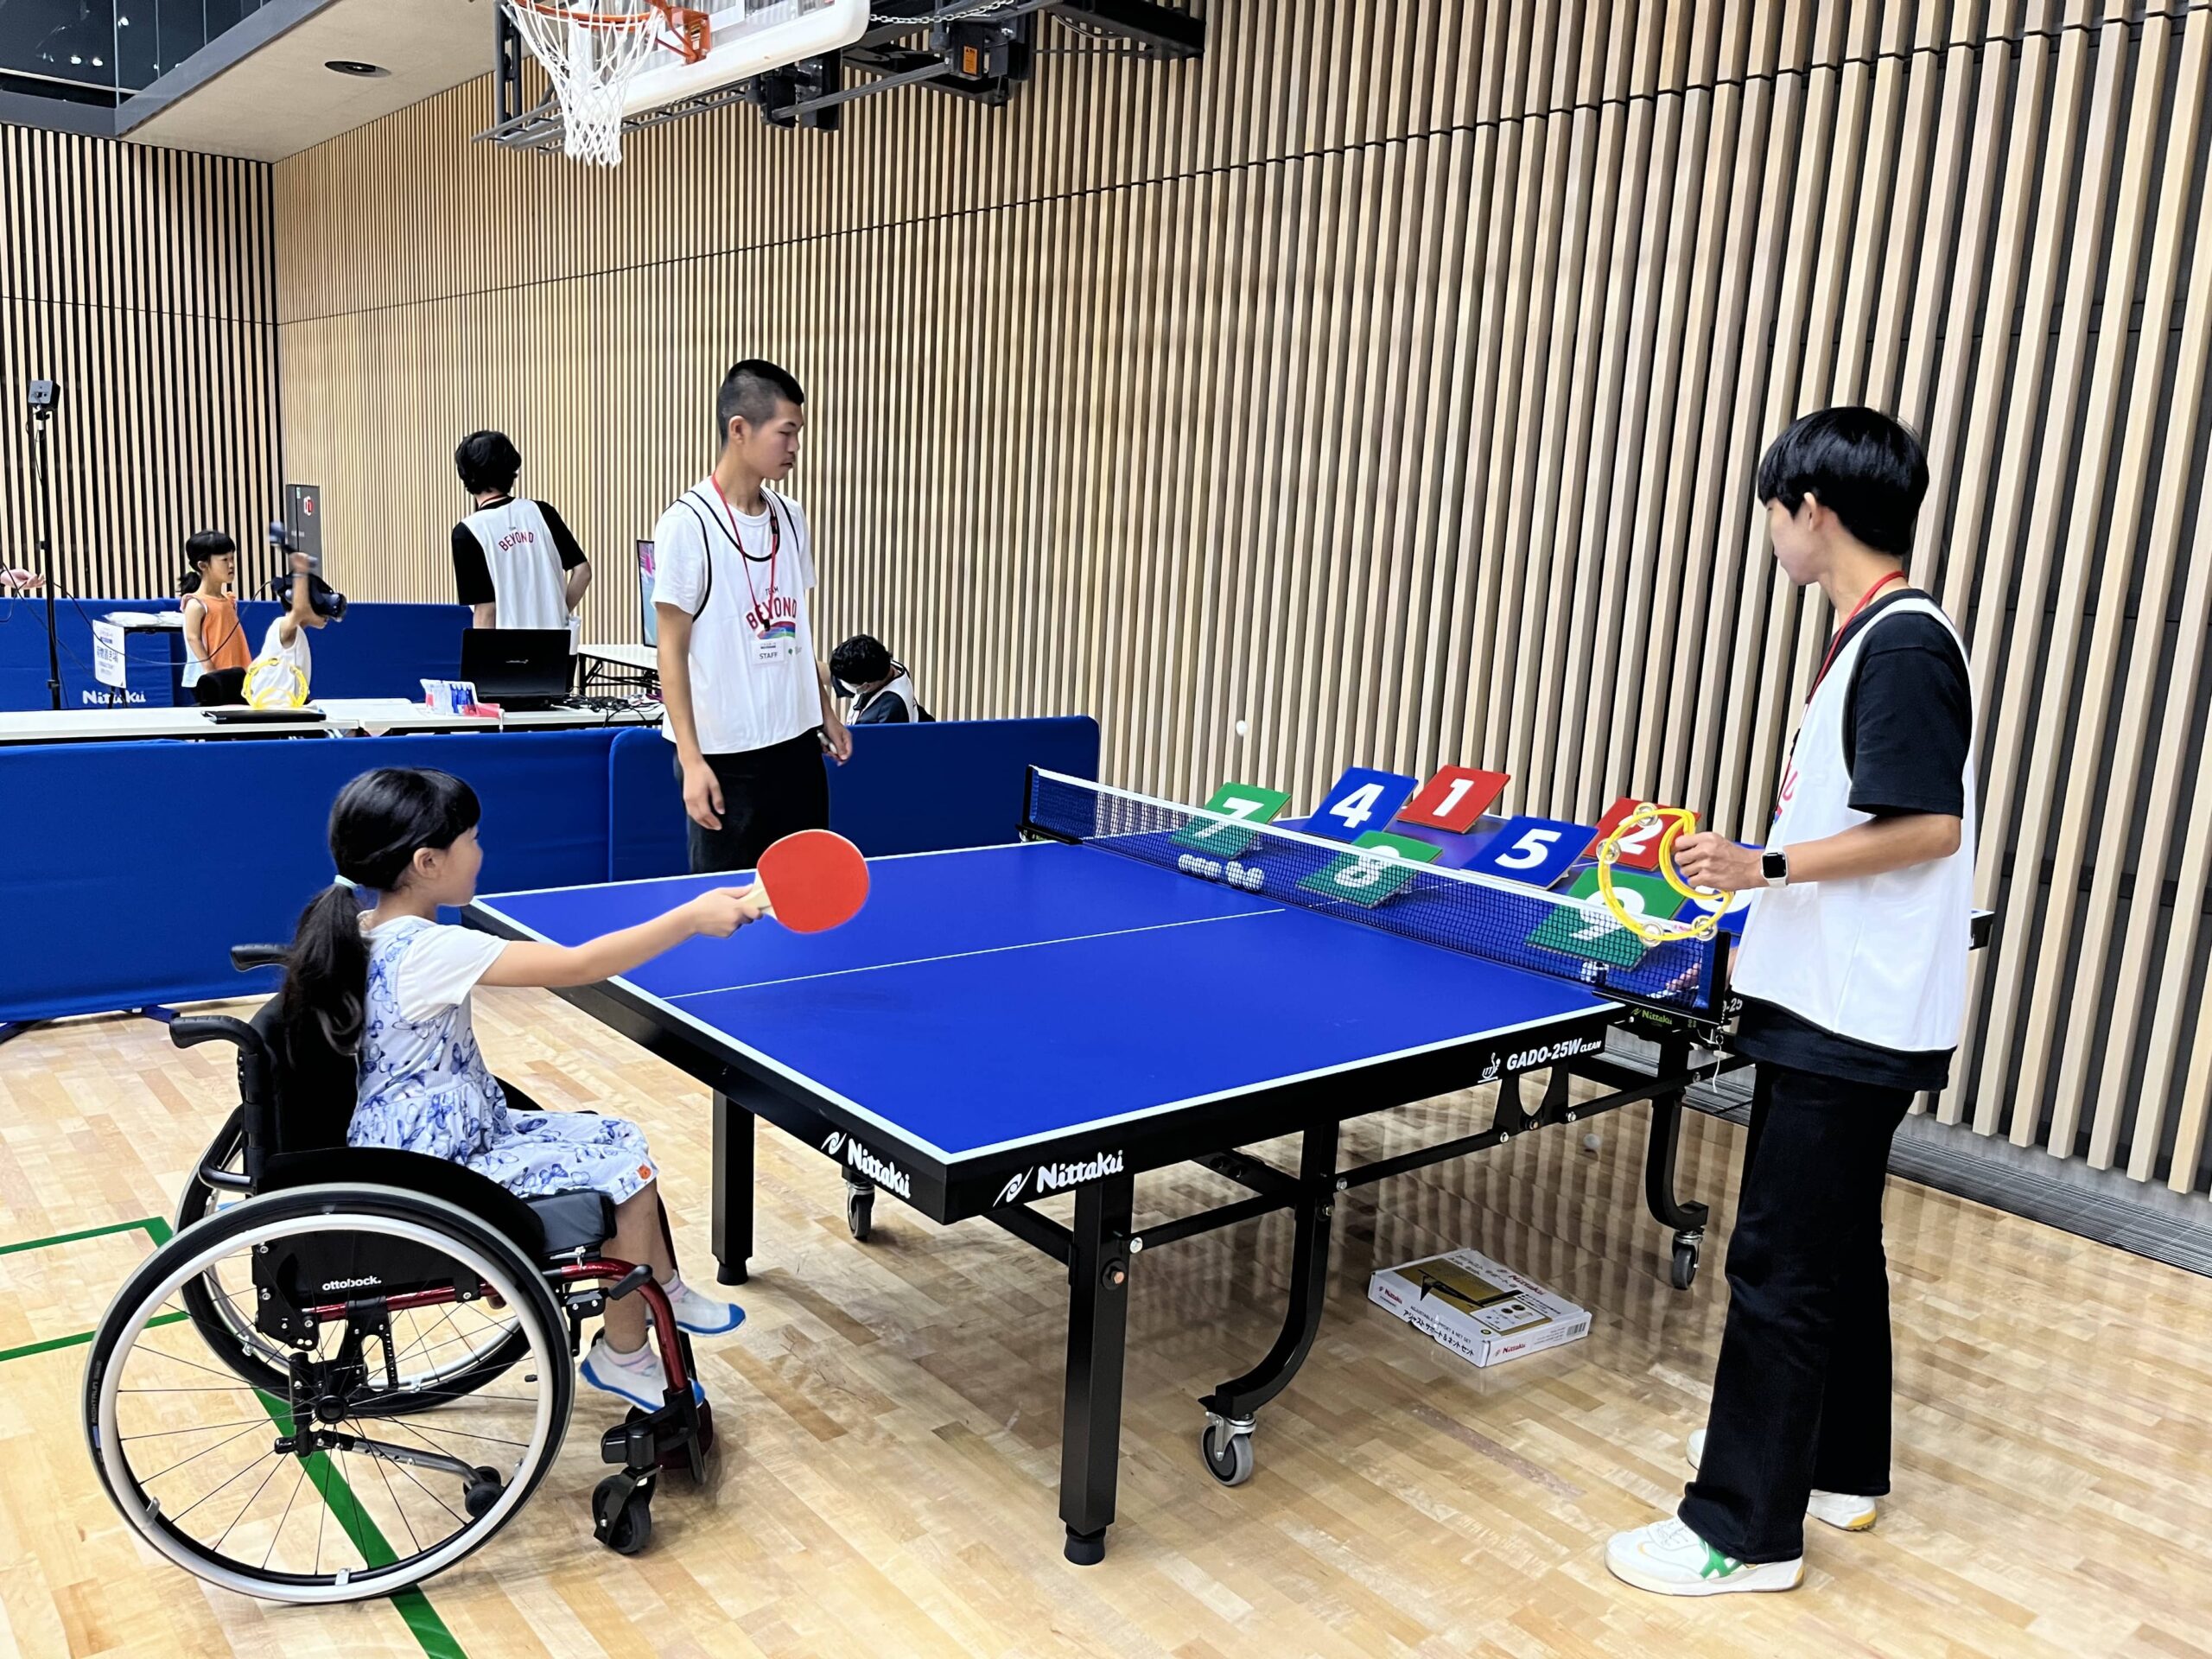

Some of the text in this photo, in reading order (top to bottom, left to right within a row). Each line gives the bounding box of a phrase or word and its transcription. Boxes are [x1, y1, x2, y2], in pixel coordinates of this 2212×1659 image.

[499, 531, 534, 551] BEYOND
[746, 597, 797, 630] BEYOND
[82, 690, 146, 704] Nitaku
[1194, 797, 1264, 838] 7
[1329, 783, 1384, 829] 4
[1433, 778, 1474, 817] 1
[1494, 828, 1561, 869] 5
[1615, 814, 1663, 855] 2
[1333, 845, 1399, 888] 8
[1568, 887, 1645, 941] 9
[1642, 1009, 1673, 1026] Nittaku
[847, 1138, 911, 1199] Nittaku
[1036, 1149, 1124, 1193] Nittaku
[1509, 1274, 1546, 1295] Nittaku
[1502, 1342, 1526, 1354] Nittaku
